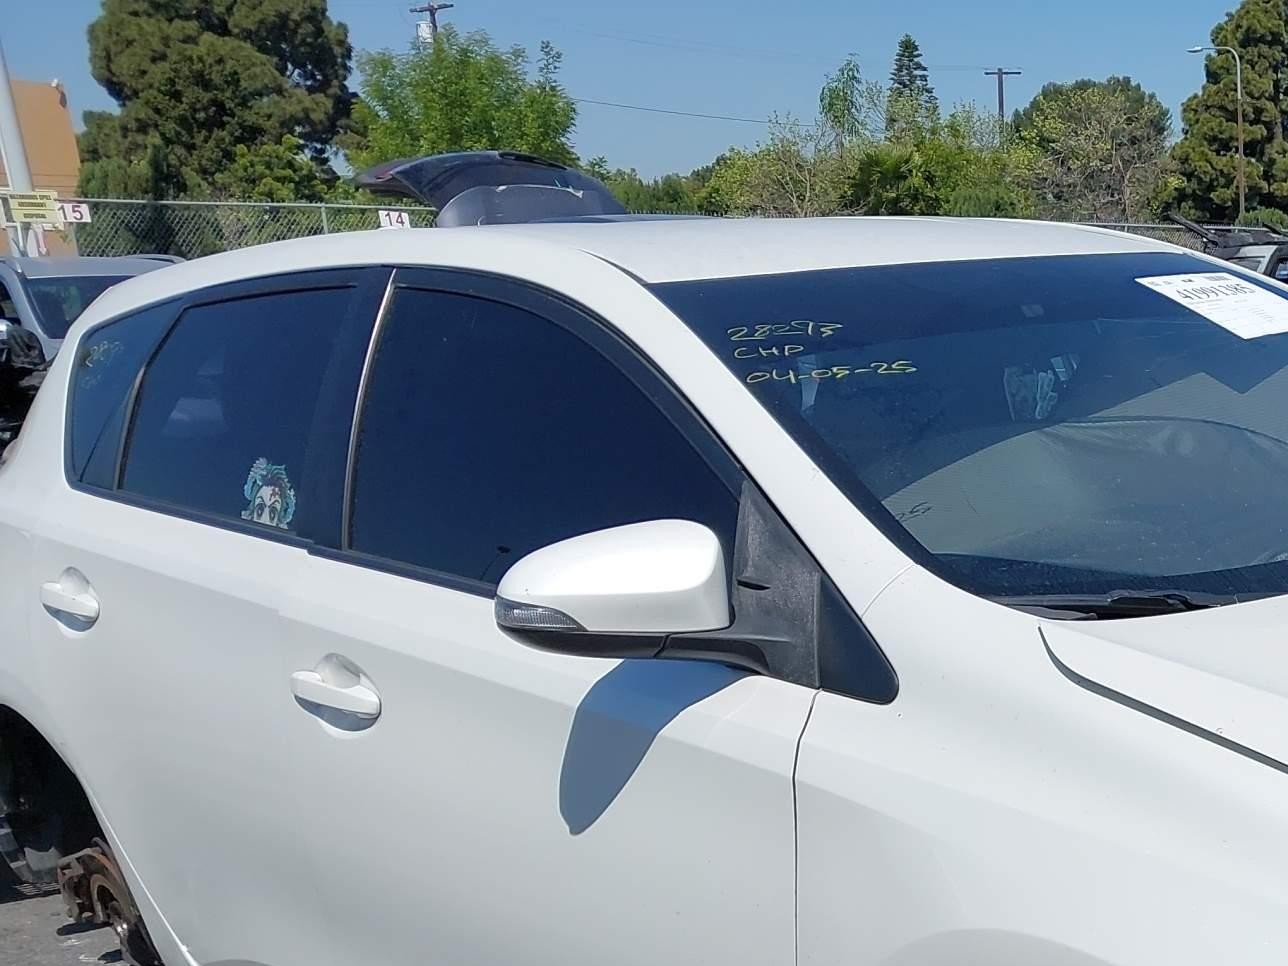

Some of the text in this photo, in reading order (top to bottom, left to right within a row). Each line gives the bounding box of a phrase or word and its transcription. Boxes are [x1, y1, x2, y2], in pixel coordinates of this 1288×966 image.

[58, 204, 84, 221] 15
[384, 211, 405, 227] 14
[1176, 282, 1257, 301] 41991385
[746, 360, 917, 384] 04-05-25
